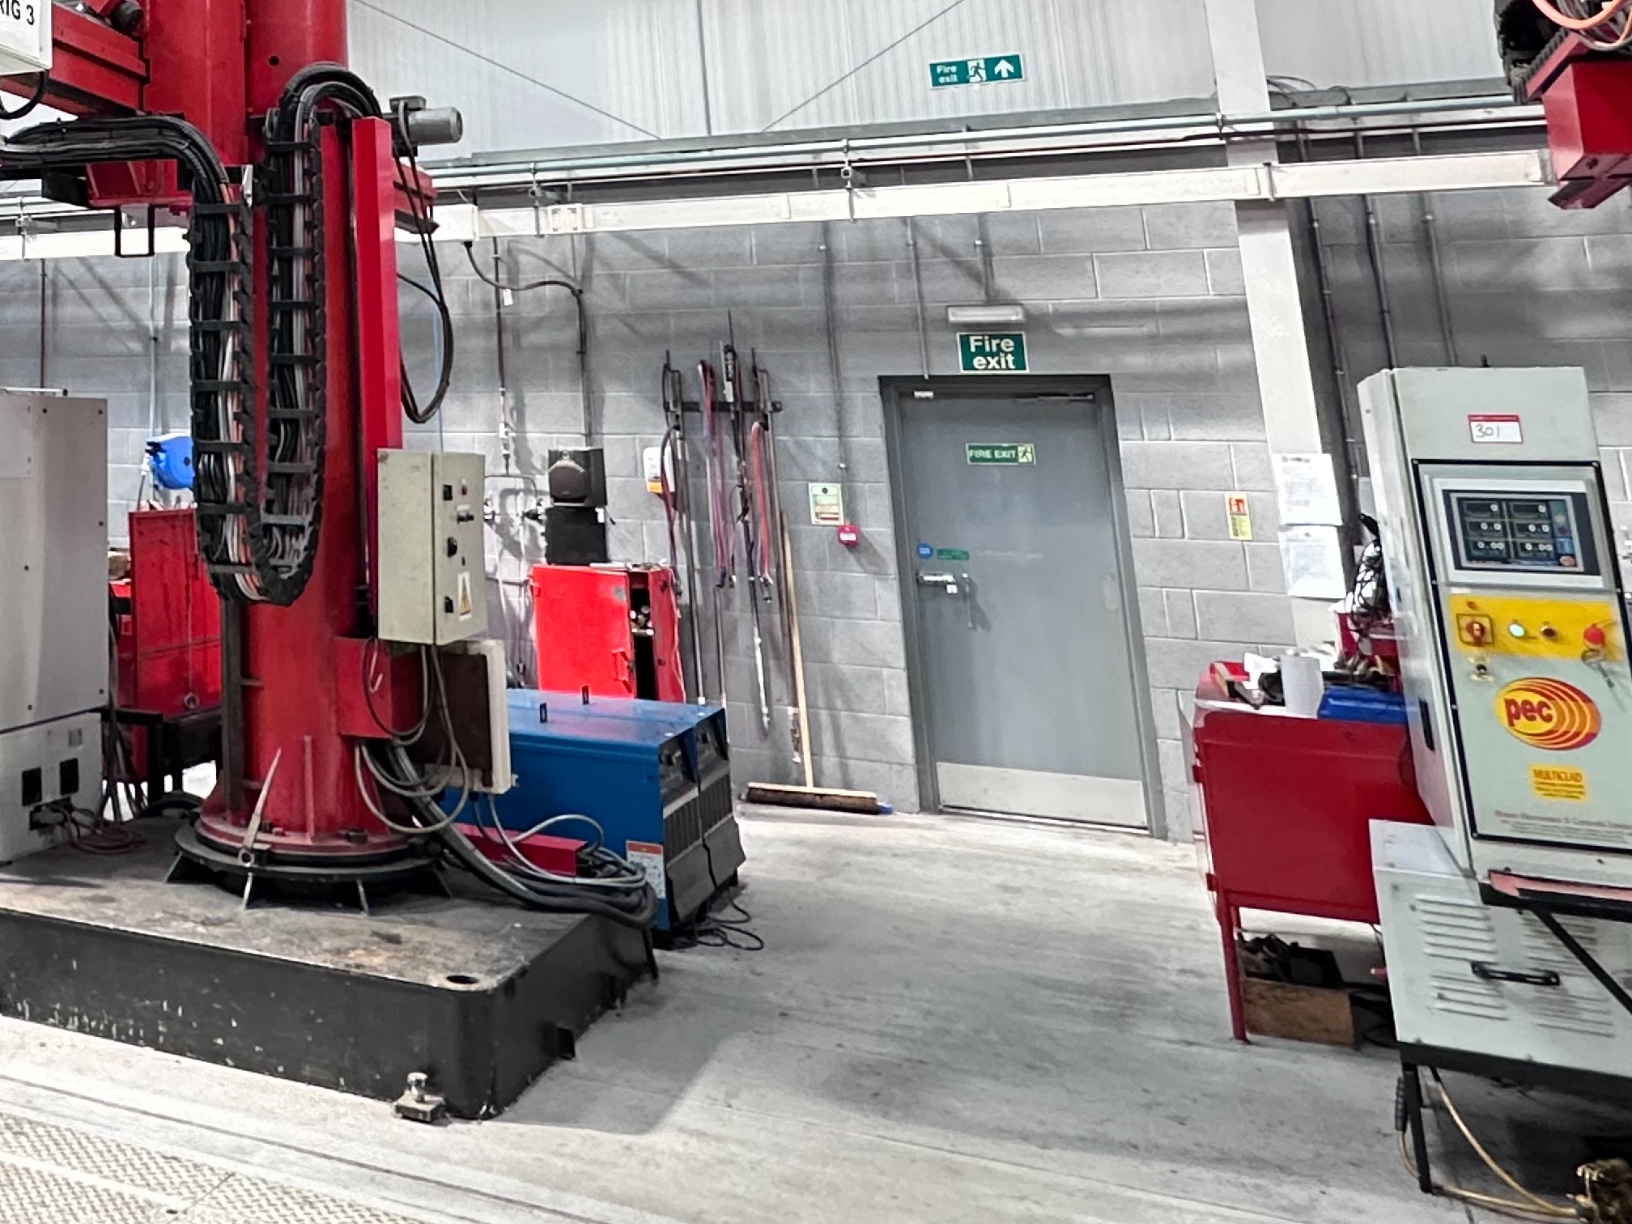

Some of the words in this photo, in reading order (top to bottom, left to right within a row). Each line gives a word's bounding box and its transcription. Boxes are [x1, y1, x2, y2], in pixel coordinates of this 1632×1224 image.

[26, 3, 35, 26] 3
[936, 64, 957, 74] Fire
[969, 335, 1015, 352] Fire
[972, 352, 1016, 370] exit
[1474, 423, 1501, 438] 301
[969, 449, 993, 459] FIRE
[994, 449, 1017, 459] EXIT
[1504, 697, 1553, 727] pec
